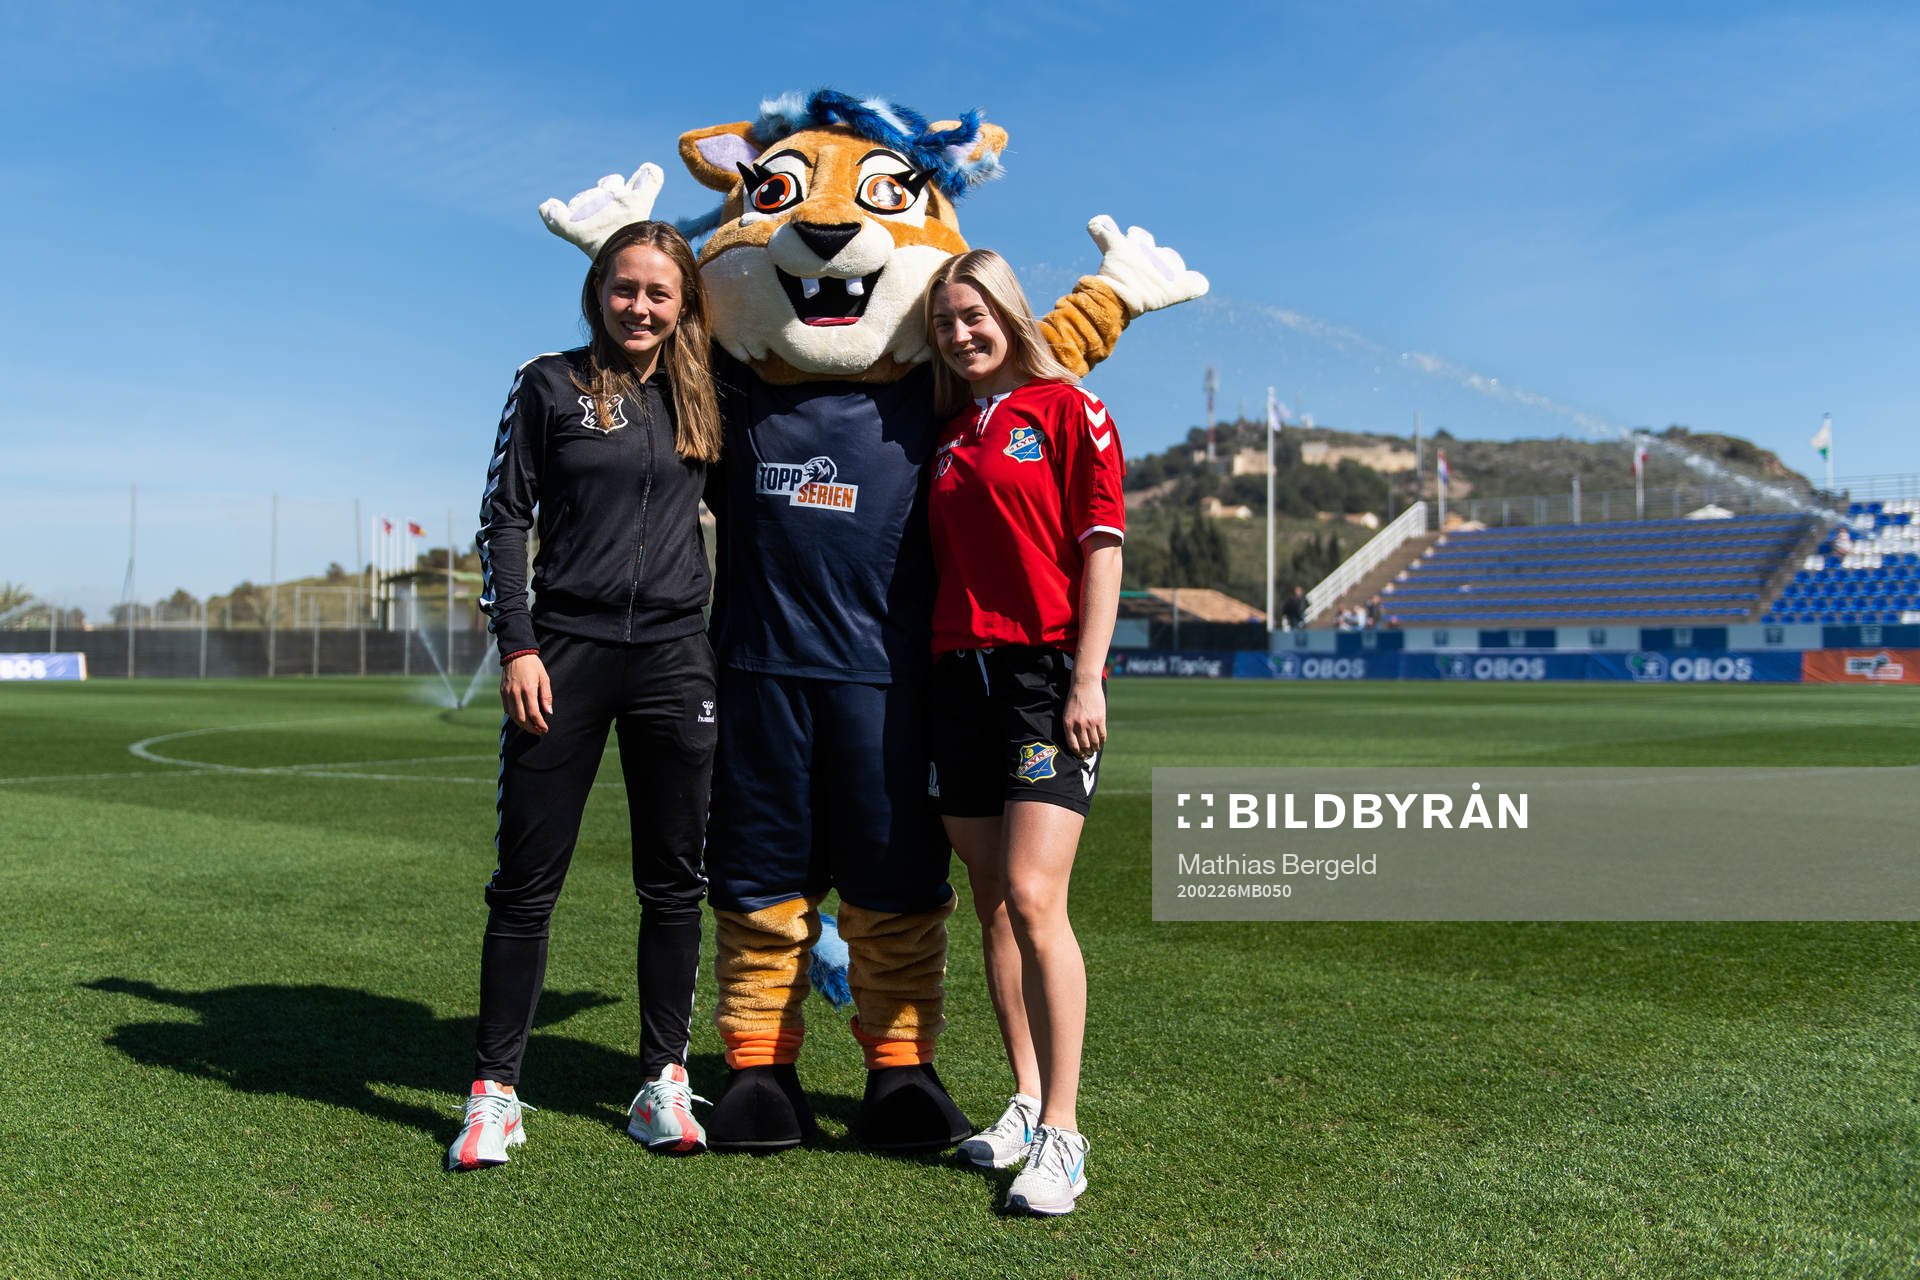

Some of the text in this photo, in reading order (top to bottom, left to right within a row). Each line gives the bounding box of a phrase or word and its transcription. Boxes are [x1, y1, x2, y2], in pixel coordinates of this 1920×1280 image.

[1015, 436, 1034, 448] LYN
[759, 467, 803, 491] TOPP
[798, 483, 854, 508] SERIEN
[1169, 655, 1222, 677] Tipping
[1302, 658, 1364, 679] OBOS
[1474, 658, 1545, 680] OBOS
[1670, 658, 1752, 681] OBOS
[1025, 752, 1044, 768] LYN
